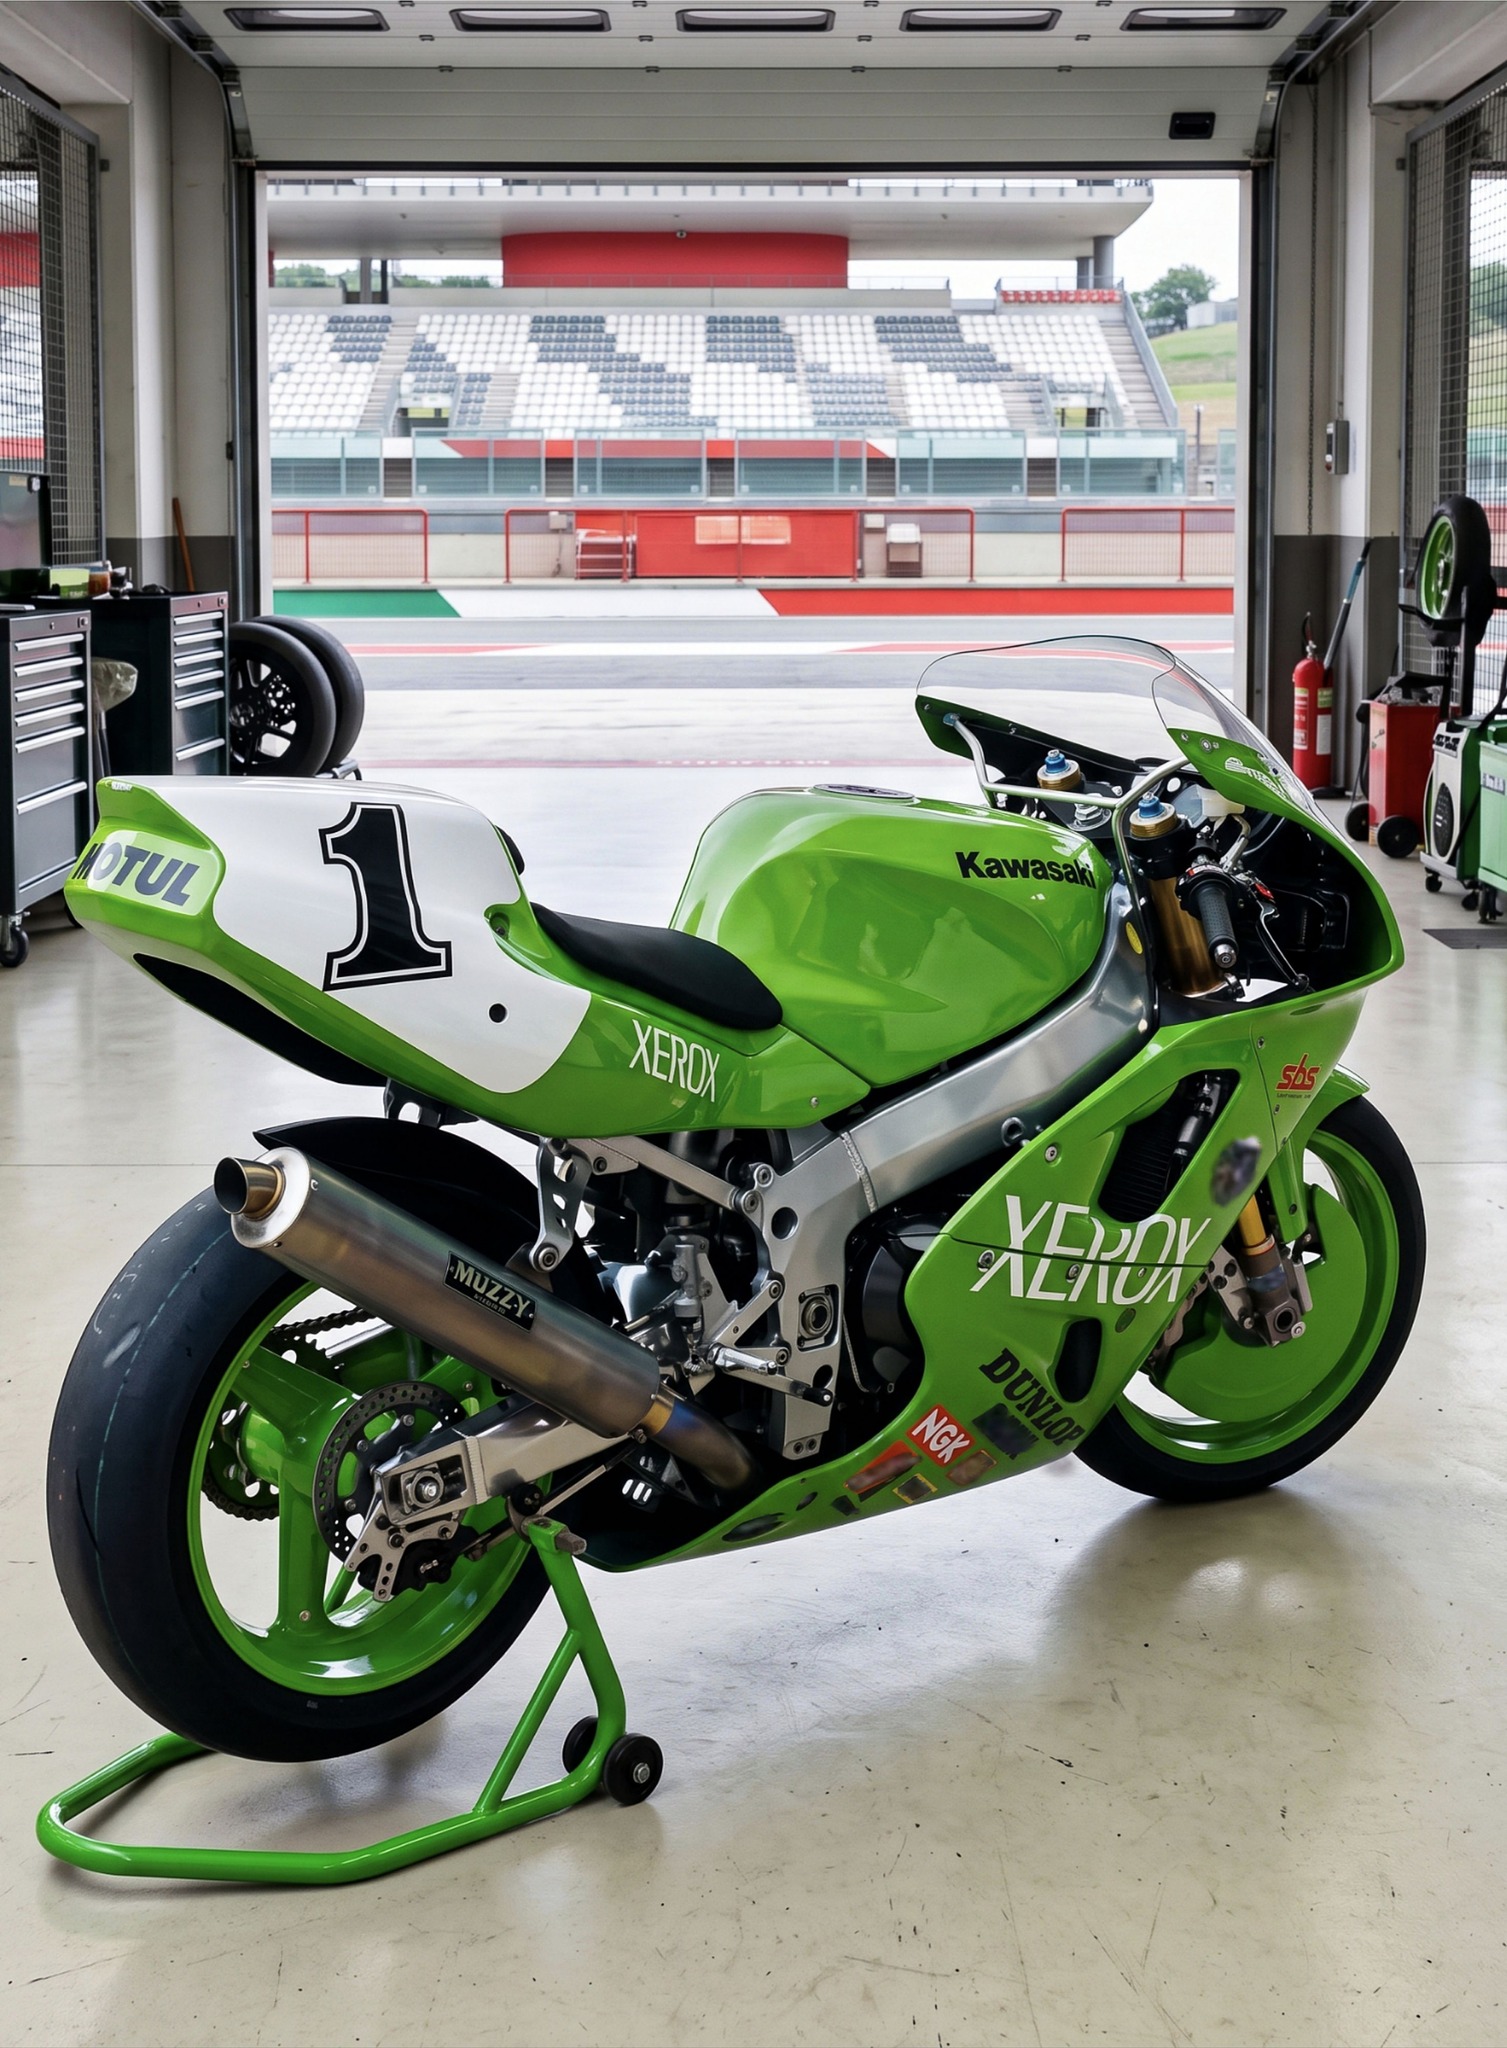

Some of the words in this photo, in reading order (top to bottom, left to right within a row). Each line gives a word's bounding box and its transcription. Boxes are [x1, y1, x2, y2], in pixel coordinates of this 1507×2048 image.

[71, 841, 200, 907] MOTUL
[318, 801, 453, 992] 1
[955, 851, 1097, 889] Kawasaki
[628, 1018, 720, 1103] XEROX
[969, 1194, 1212, 1305] XEROX
[453, 1259, 531, 1318] MUZZY
[979, 1347, 1086, 1447] DUNLOP
[911, 1408, 970, 1464] NGK
